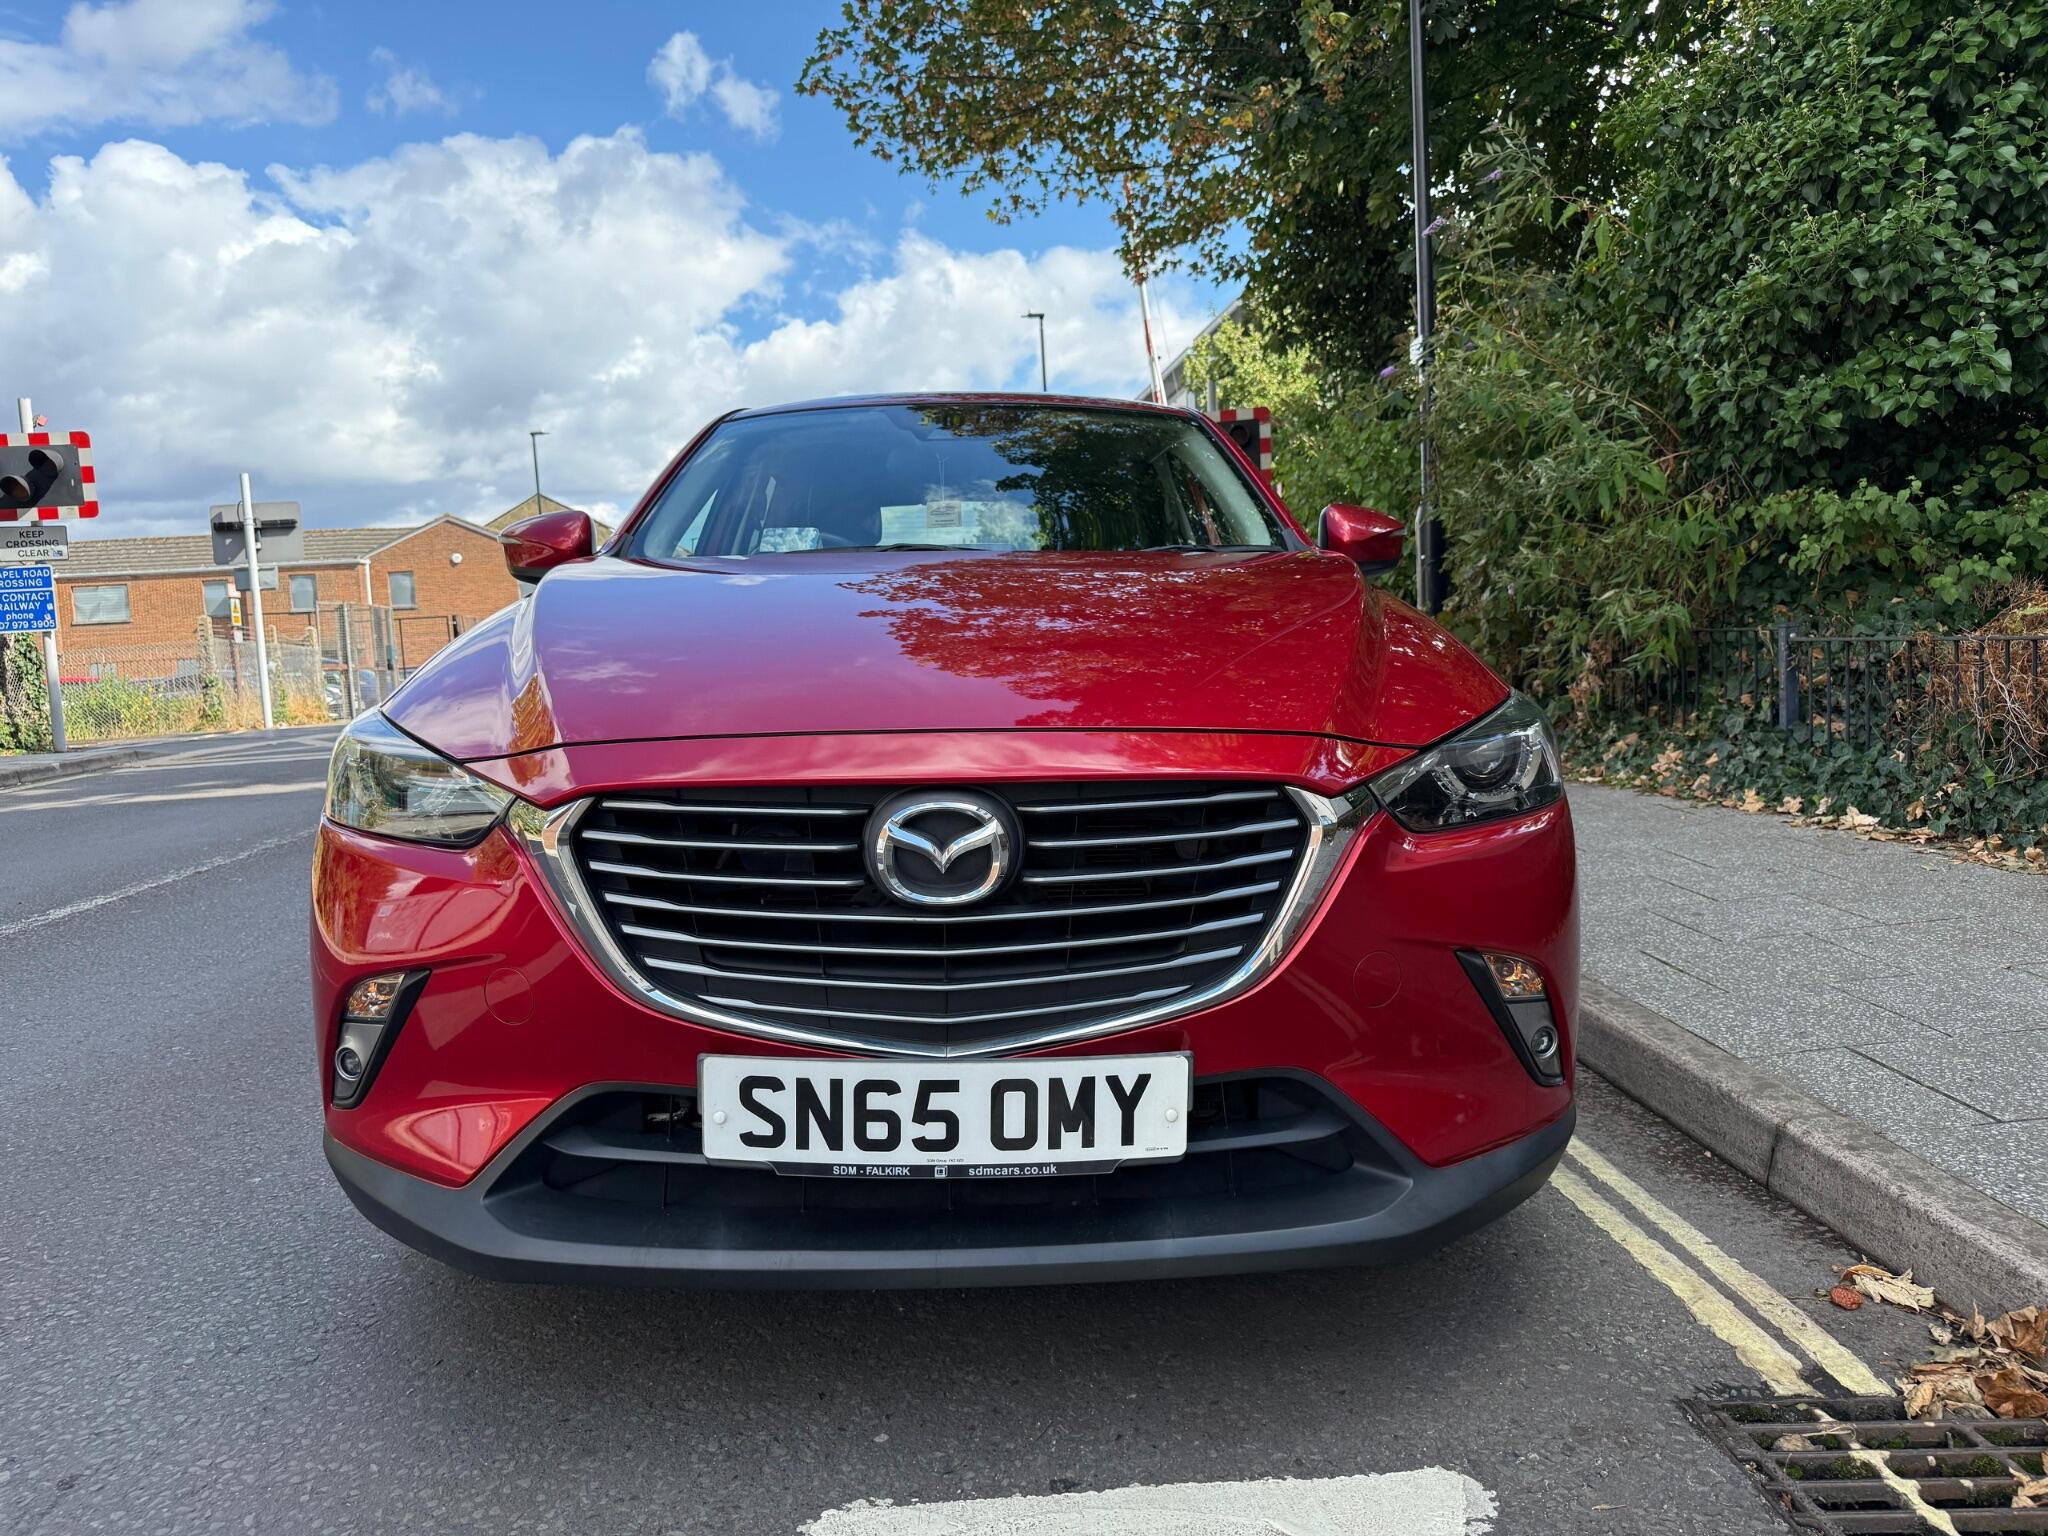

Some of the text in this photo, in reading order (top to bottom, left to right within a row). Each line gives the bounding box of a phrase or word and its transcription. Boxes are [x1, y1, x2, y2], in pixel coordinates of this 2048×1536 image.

[19, 530, 44, 538] KEEP
[6, 539, 60, 548] CROSSING
[23, 569, 50, 578] ROAD
[2, 592, 50, 602] CONTACT
[6, 612, 34, 621] phone
[31, 619, 55, 628] 3905
[739, 1073, 1152, 1152] SN65 OMY
[833, 1165, 857, 1175] SDM
[866, 1166, 910, 1176] FALKIRK
[968, 1163, 1057, 1176] sdmcars.co.uk
